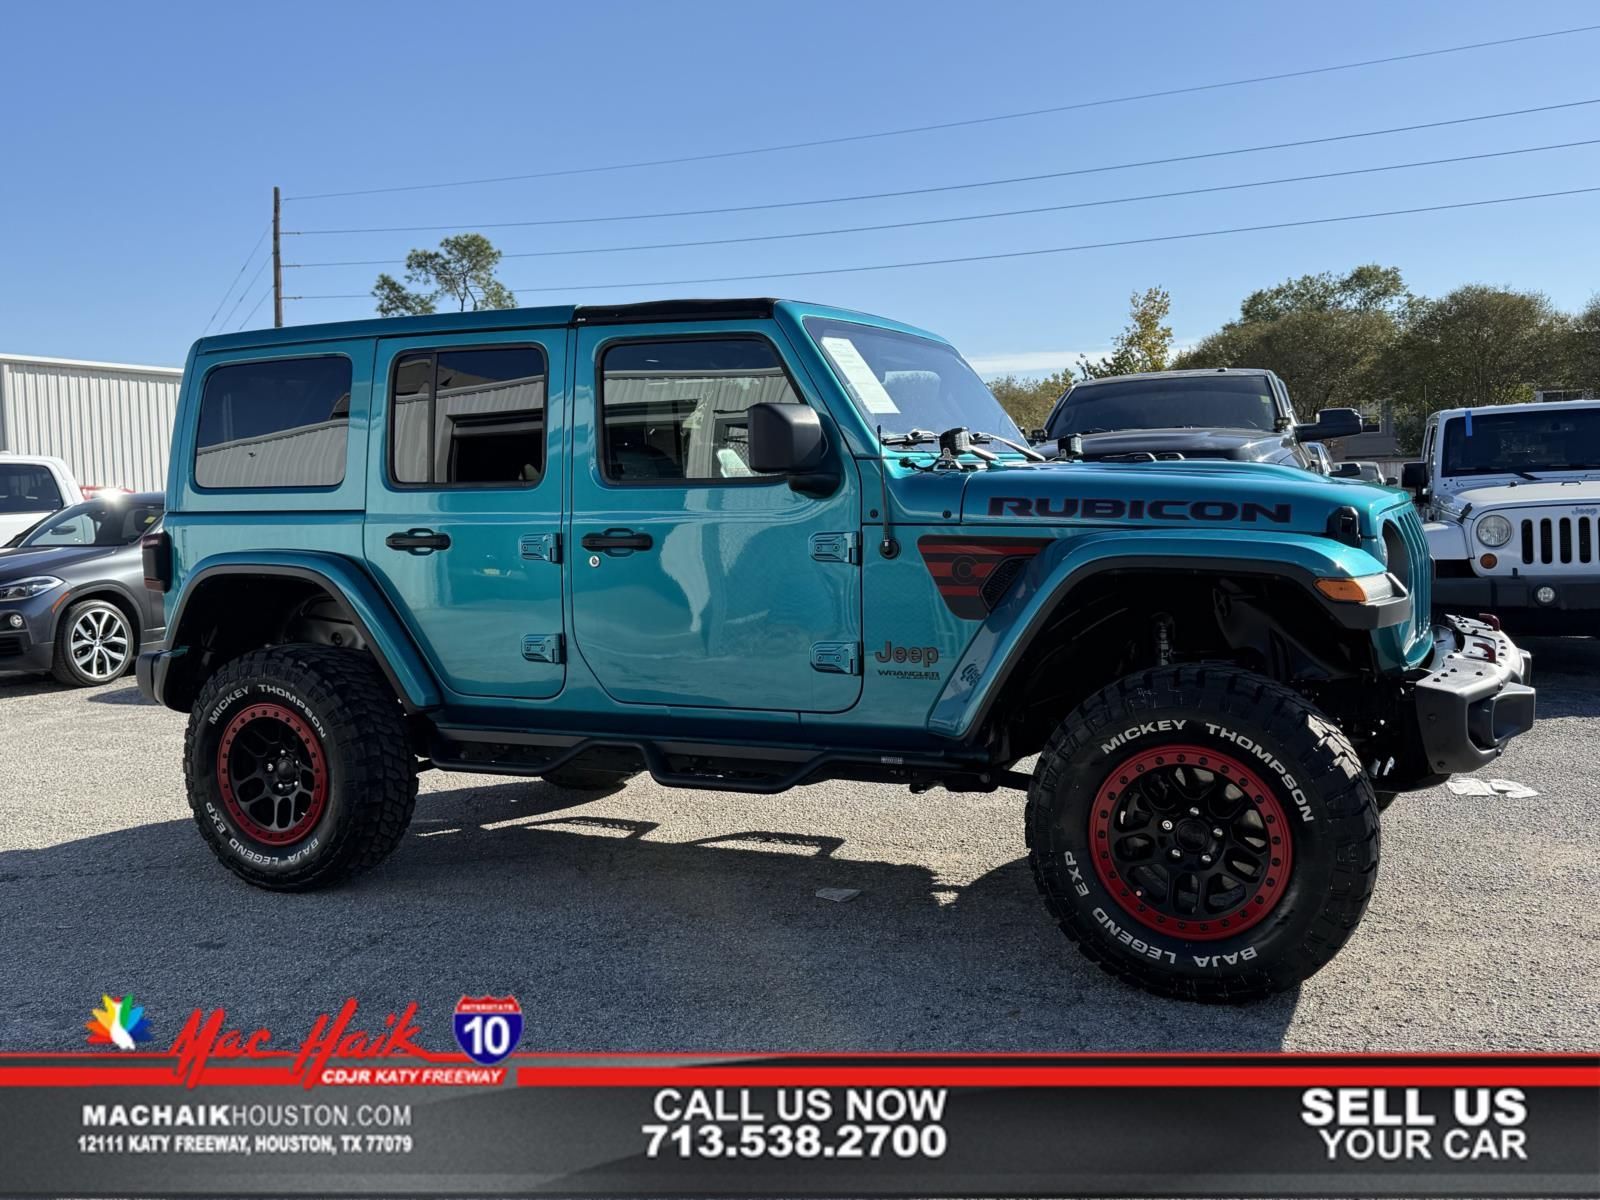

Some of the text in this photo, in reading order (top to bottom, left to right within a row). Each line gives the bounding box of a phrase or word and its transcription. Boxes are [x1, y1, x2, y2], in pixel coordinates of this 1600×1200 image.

[987, 496, 1292, 524] RUBICON
[875, 640, 939, 668] Jeep
[878, 669, 940, 678] WRANGLER
[208, 683, 327, 739] MICKEY THOMPSON
[1101, 719, 1314, 822] MICKEY THOMPSON
[205, 802, 320, 865] BAJA LEGEND EXP
[1063, 850, 1258, 968] BAJA LEGEND EXP
